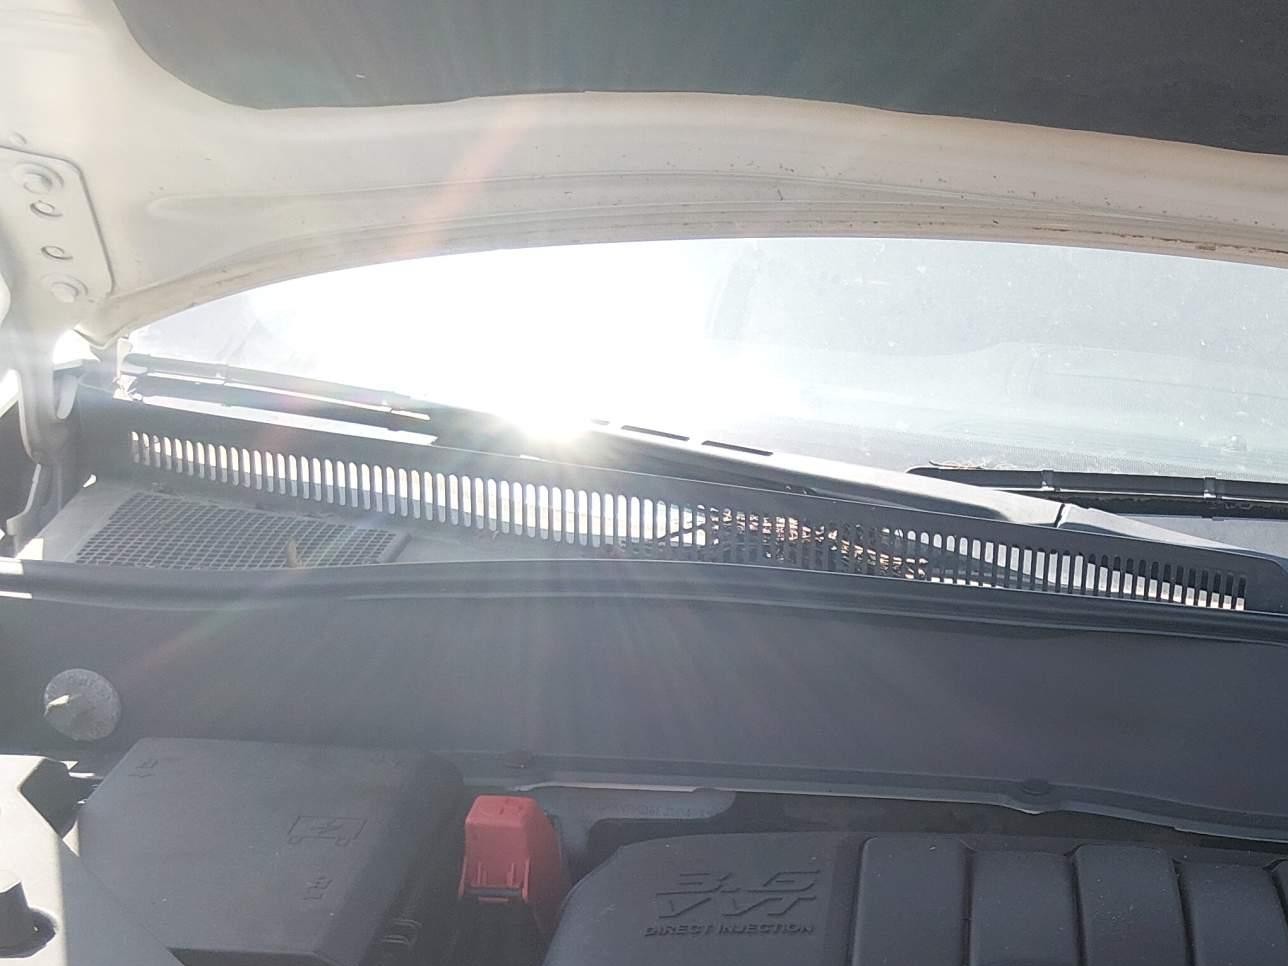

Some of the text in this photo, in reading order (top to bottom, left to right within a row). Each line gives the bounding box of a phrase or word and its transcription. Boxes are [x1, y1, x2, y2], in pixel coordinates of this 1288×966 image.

[655, 869, 821, 896] 3.6
[656, 895, 819, 919] VVT
[643, 923, 817, 938] DIRECT INJECTION
